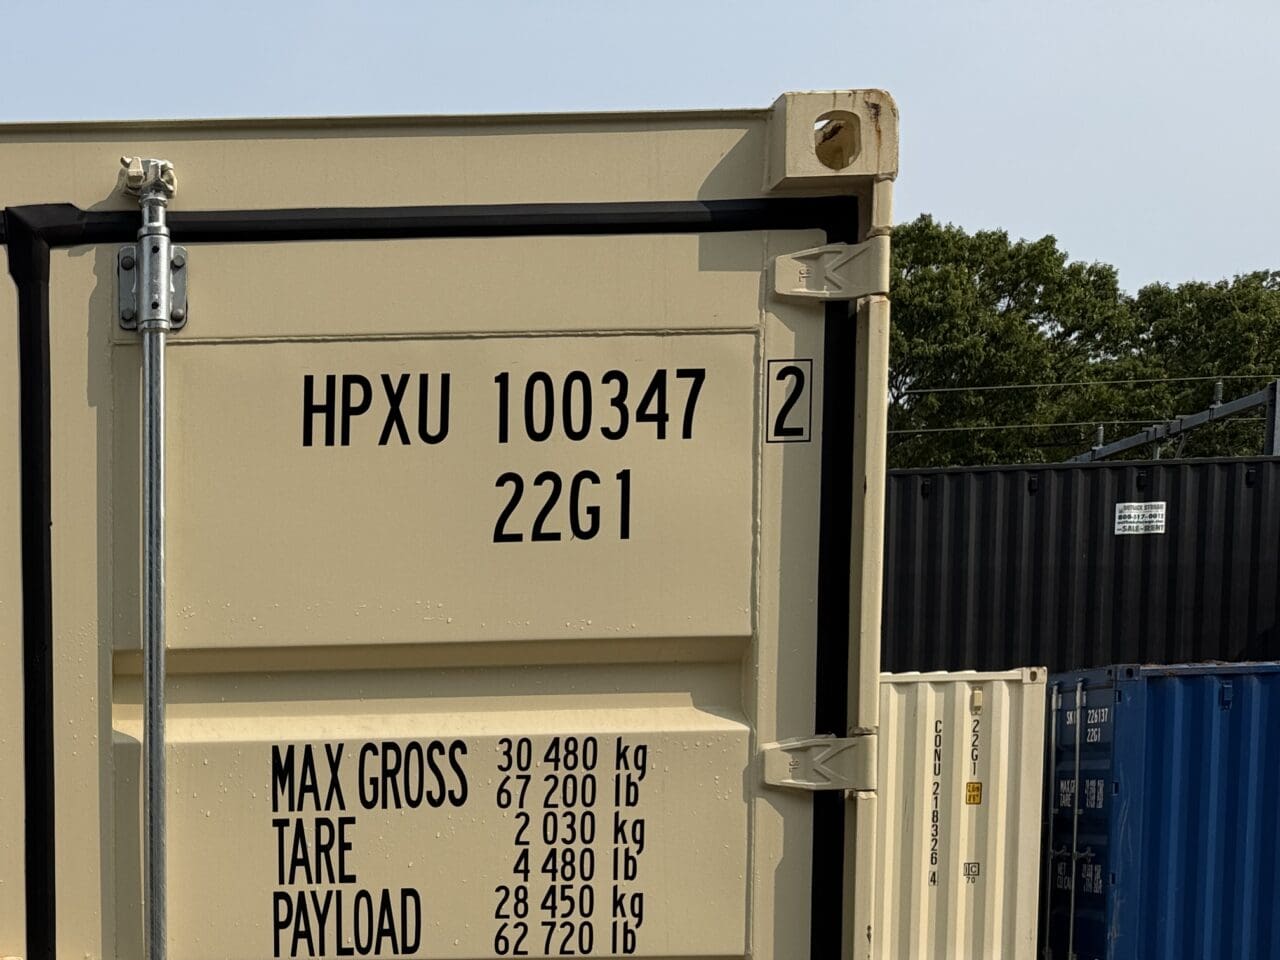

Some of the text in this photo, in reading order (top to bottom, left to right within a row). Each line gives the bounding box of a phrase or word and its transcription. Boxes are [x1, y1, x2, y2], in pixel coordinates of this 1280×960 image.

[303, 365, 806, 447] HPXU 100347 2
[493, 469, 632, 543] 22G1
[1086, 728, 1101, 743] 22G1
[1088, 708, 1108, 724] 226137
[497, 736, 647, 781] 30 480 kg
[933, 720, 942, 777] CONU
[971, 719, 980, 776] 22G1
[272, 739, 468, 813] MAX GROSS
[496, 772, 639, 809] 67 200 lb
[514, 811, 645, 855] 2 030 kg
[930, 781, 940, 866] 218326
[272, 817, 357, 885] TARE
[513, 847, 638, 882] 4 480 lb
[273, 888, 421, 958] PAYLOAD
[494, 885, 644, 929] 28 450 kg
[494, 920, 636, 956] 62 720 lb
